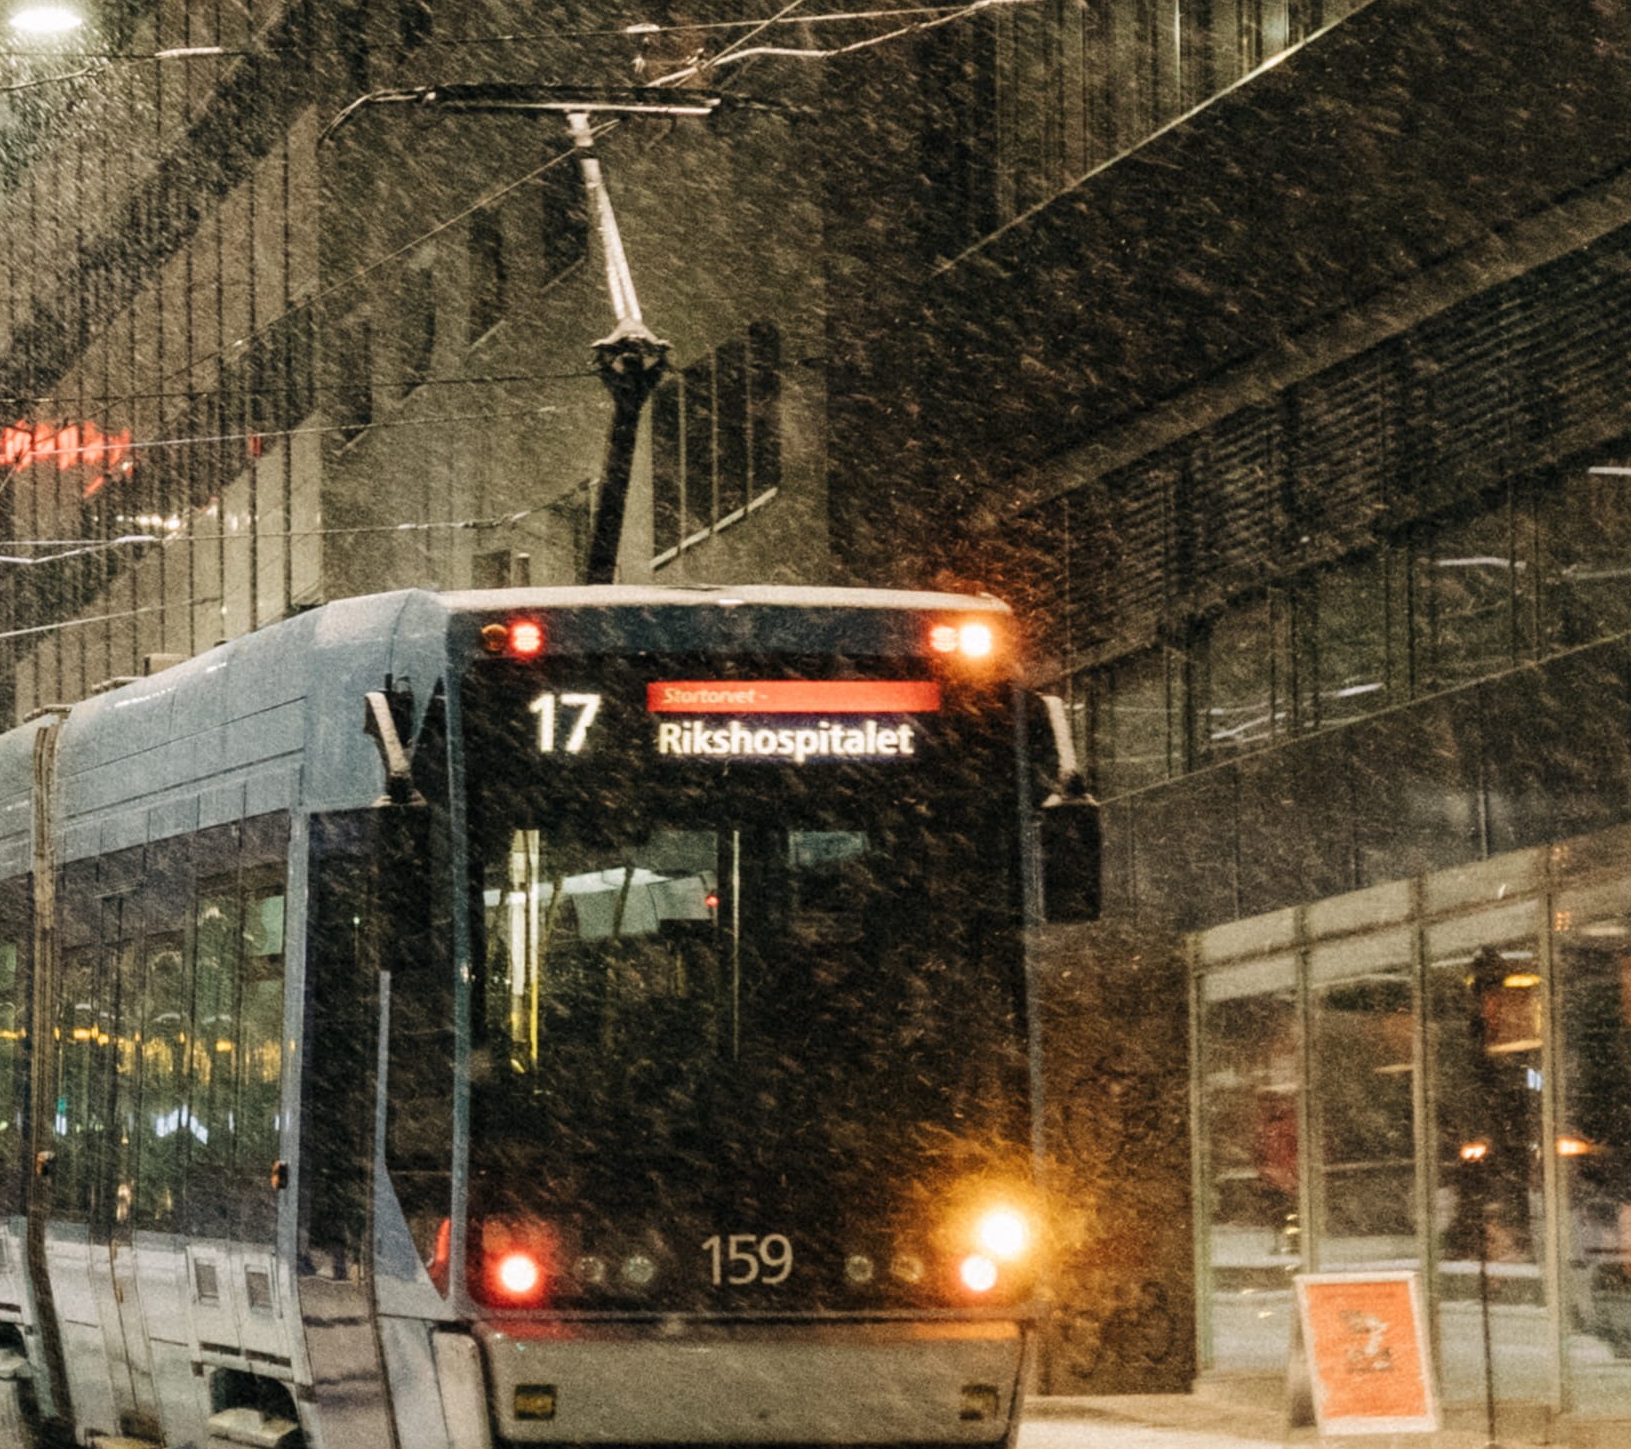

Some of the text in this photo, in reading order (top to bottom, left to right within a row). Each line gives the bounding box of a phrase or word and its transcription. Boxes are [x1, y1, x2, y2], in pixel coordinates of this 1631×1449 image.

[529, 693, 602, 753] 17
[659, 720, 915, 763] Rikshospitalet
[702, 1233, 793, 1286] 159
